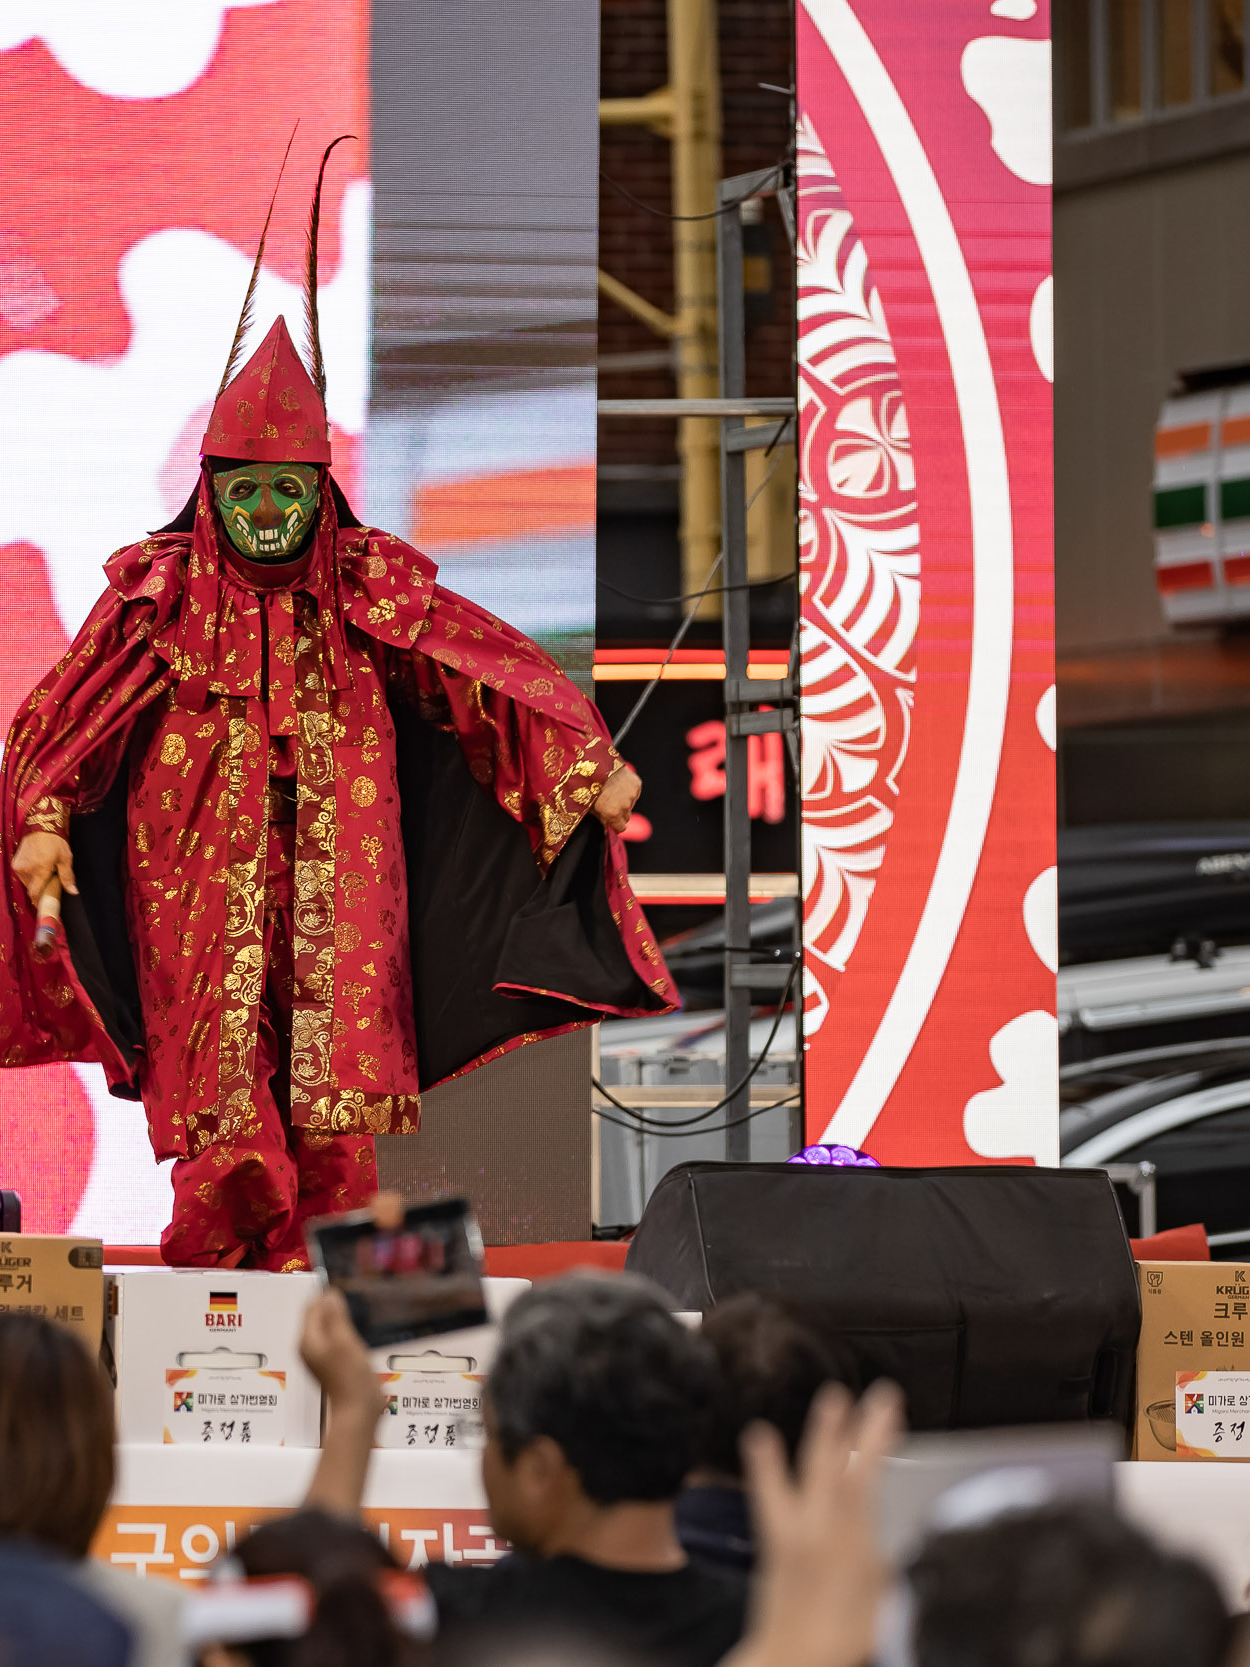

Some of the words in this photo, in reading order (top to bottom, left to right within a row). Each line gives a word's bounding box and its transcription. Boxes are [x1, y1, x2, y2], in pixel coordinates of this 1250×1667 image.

[54, 1305, 85, 1321] 세트
[1214, 1302, 1248, 1320] 크루
[205, 1313, 242, 1327] BARI
[1164, 1330, 1193, 1346] 스텐
[1200, 1331, 1244, 1347] 올인원
[198, 1393, 226, 1406] 미가로
[403, 1396, 430, 1408] 미가로
[434, 1397, 482, 1409] 상가번영회
[1208, 1395, 1235, 1406] 미가로
[1239, 1395, 1250, 1406] 상
